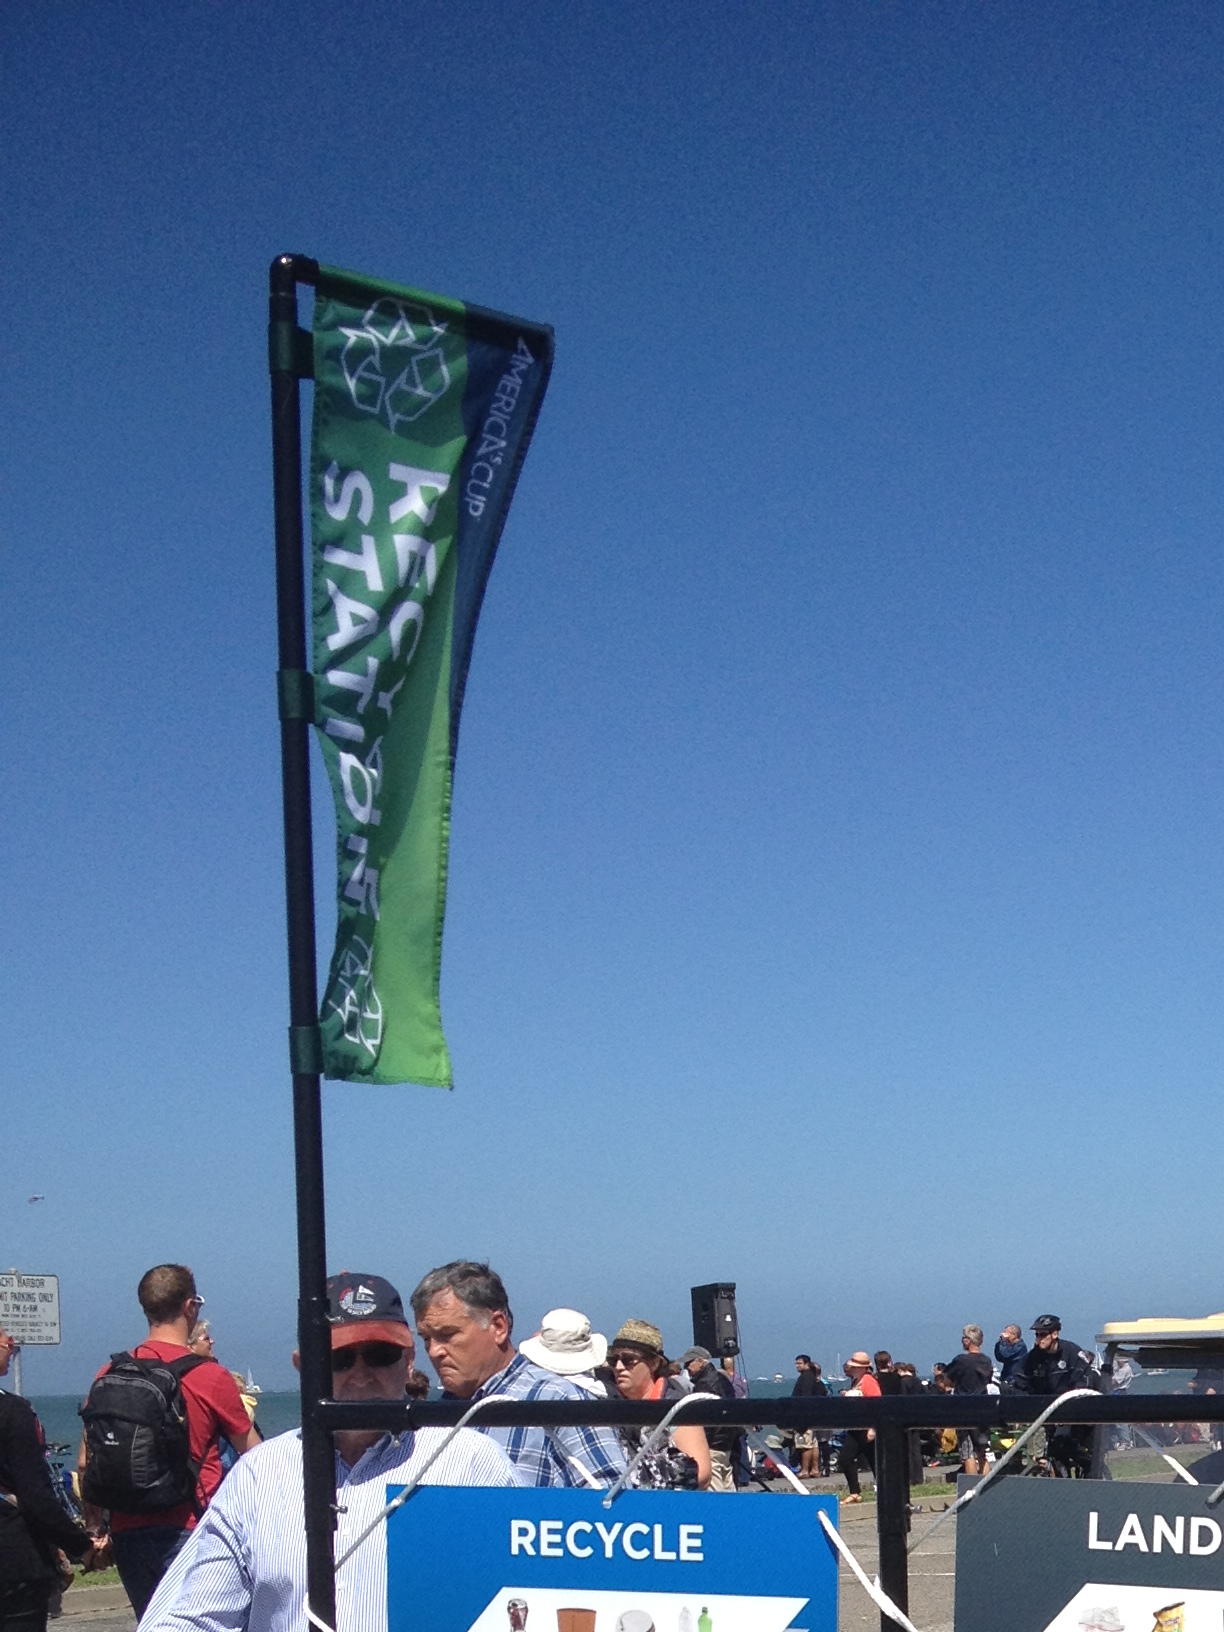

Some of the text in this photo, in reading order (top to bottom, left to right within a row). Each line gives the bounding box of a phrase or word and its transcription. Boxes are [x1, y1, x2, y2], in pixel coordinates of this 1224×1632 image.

[465, 462, 494, 518] CUP
[10, 1291, 37, 1303] PARKING
[38, 1292, 54, 1303] ONLY
[510, 1519, 705, 1562] RECYCLE
